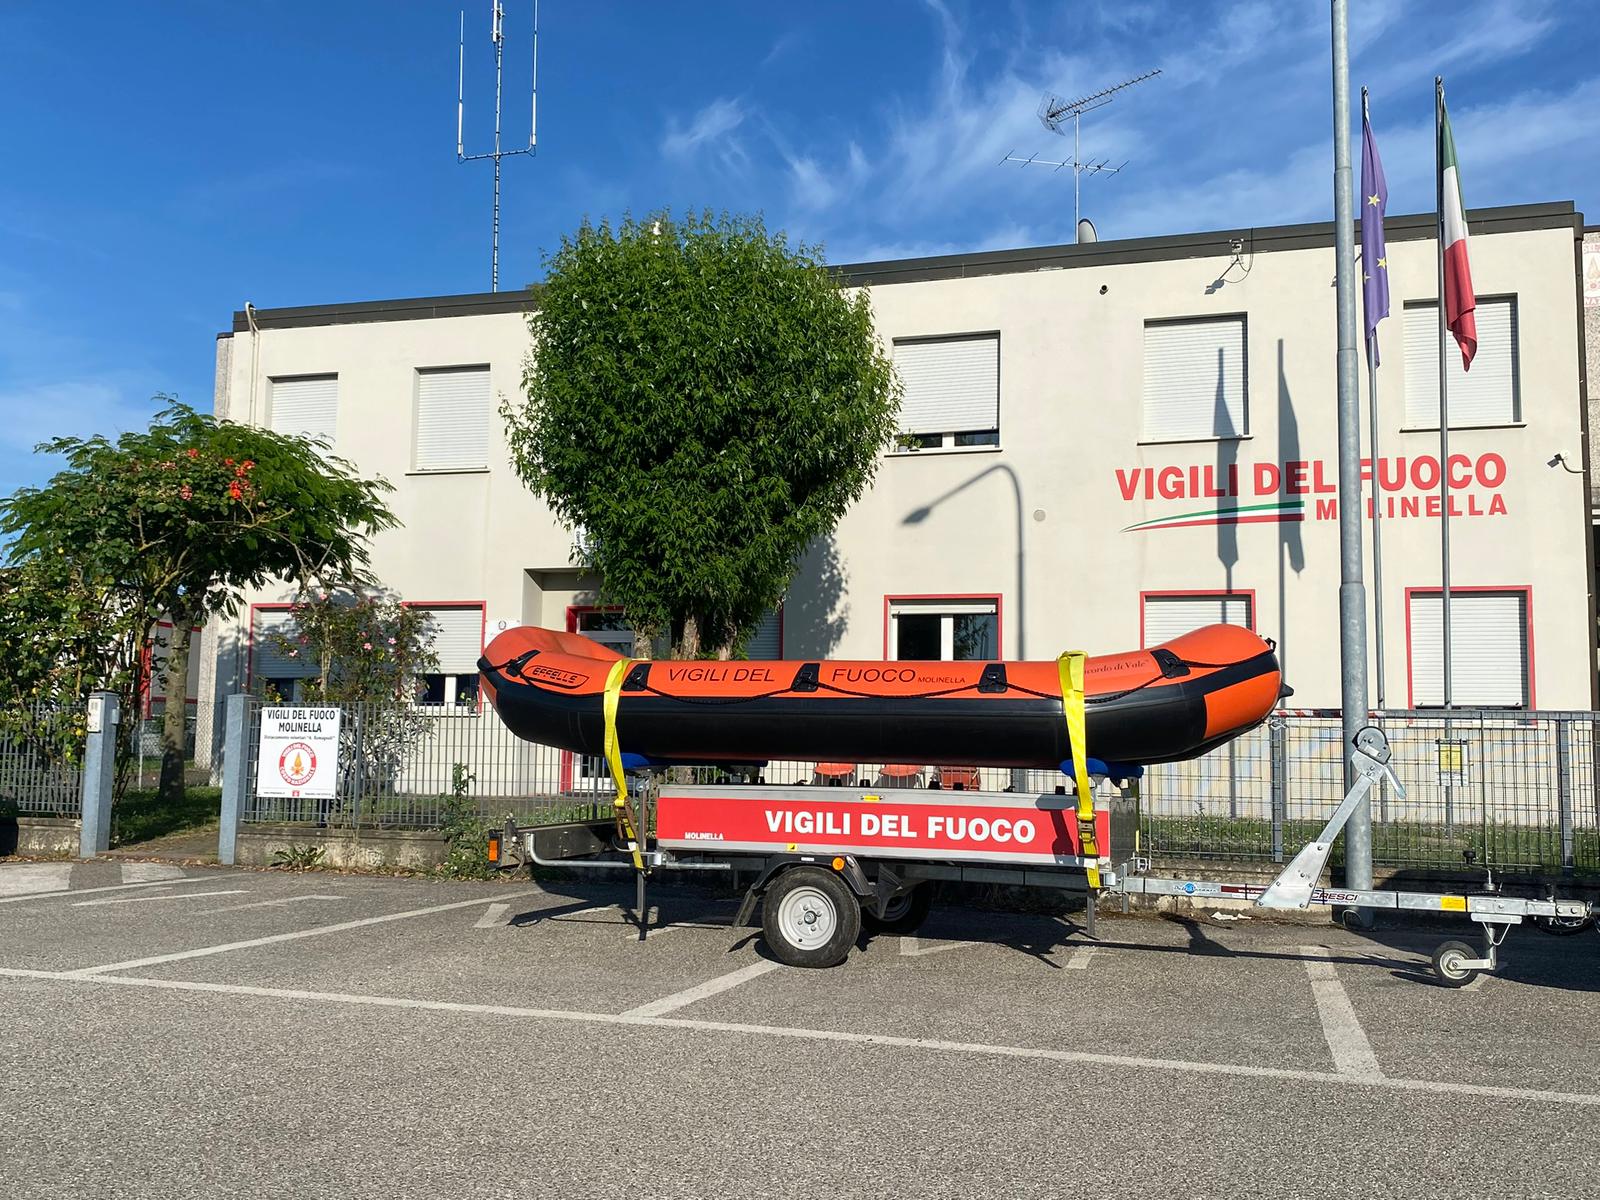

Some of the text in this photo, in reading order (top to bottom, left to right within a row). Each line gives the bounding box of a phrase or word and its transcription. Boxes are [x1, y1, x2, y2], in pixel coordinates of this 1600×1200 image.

[1115, 463, 1238, 500] VIGILI
[1253, 460, 1336, 496] DEL
[1316, 493, 1508, 521] MLINELLA
[532, 667, 578, 683] EFFELLE
[668, 668, 731, 682] VIGILI
[733, 668, 775, 682] DEL
[831, 668, 916, 683] FUOCO
[267, 709, 336, 720] VIGILI DEL FUOCO
[278, 722, 322, 732] MOLINELLA
[765, 810, 1036, 844] VIGILI DEL FUOCO
[684, 832, 724, 840] MOLINELLA
